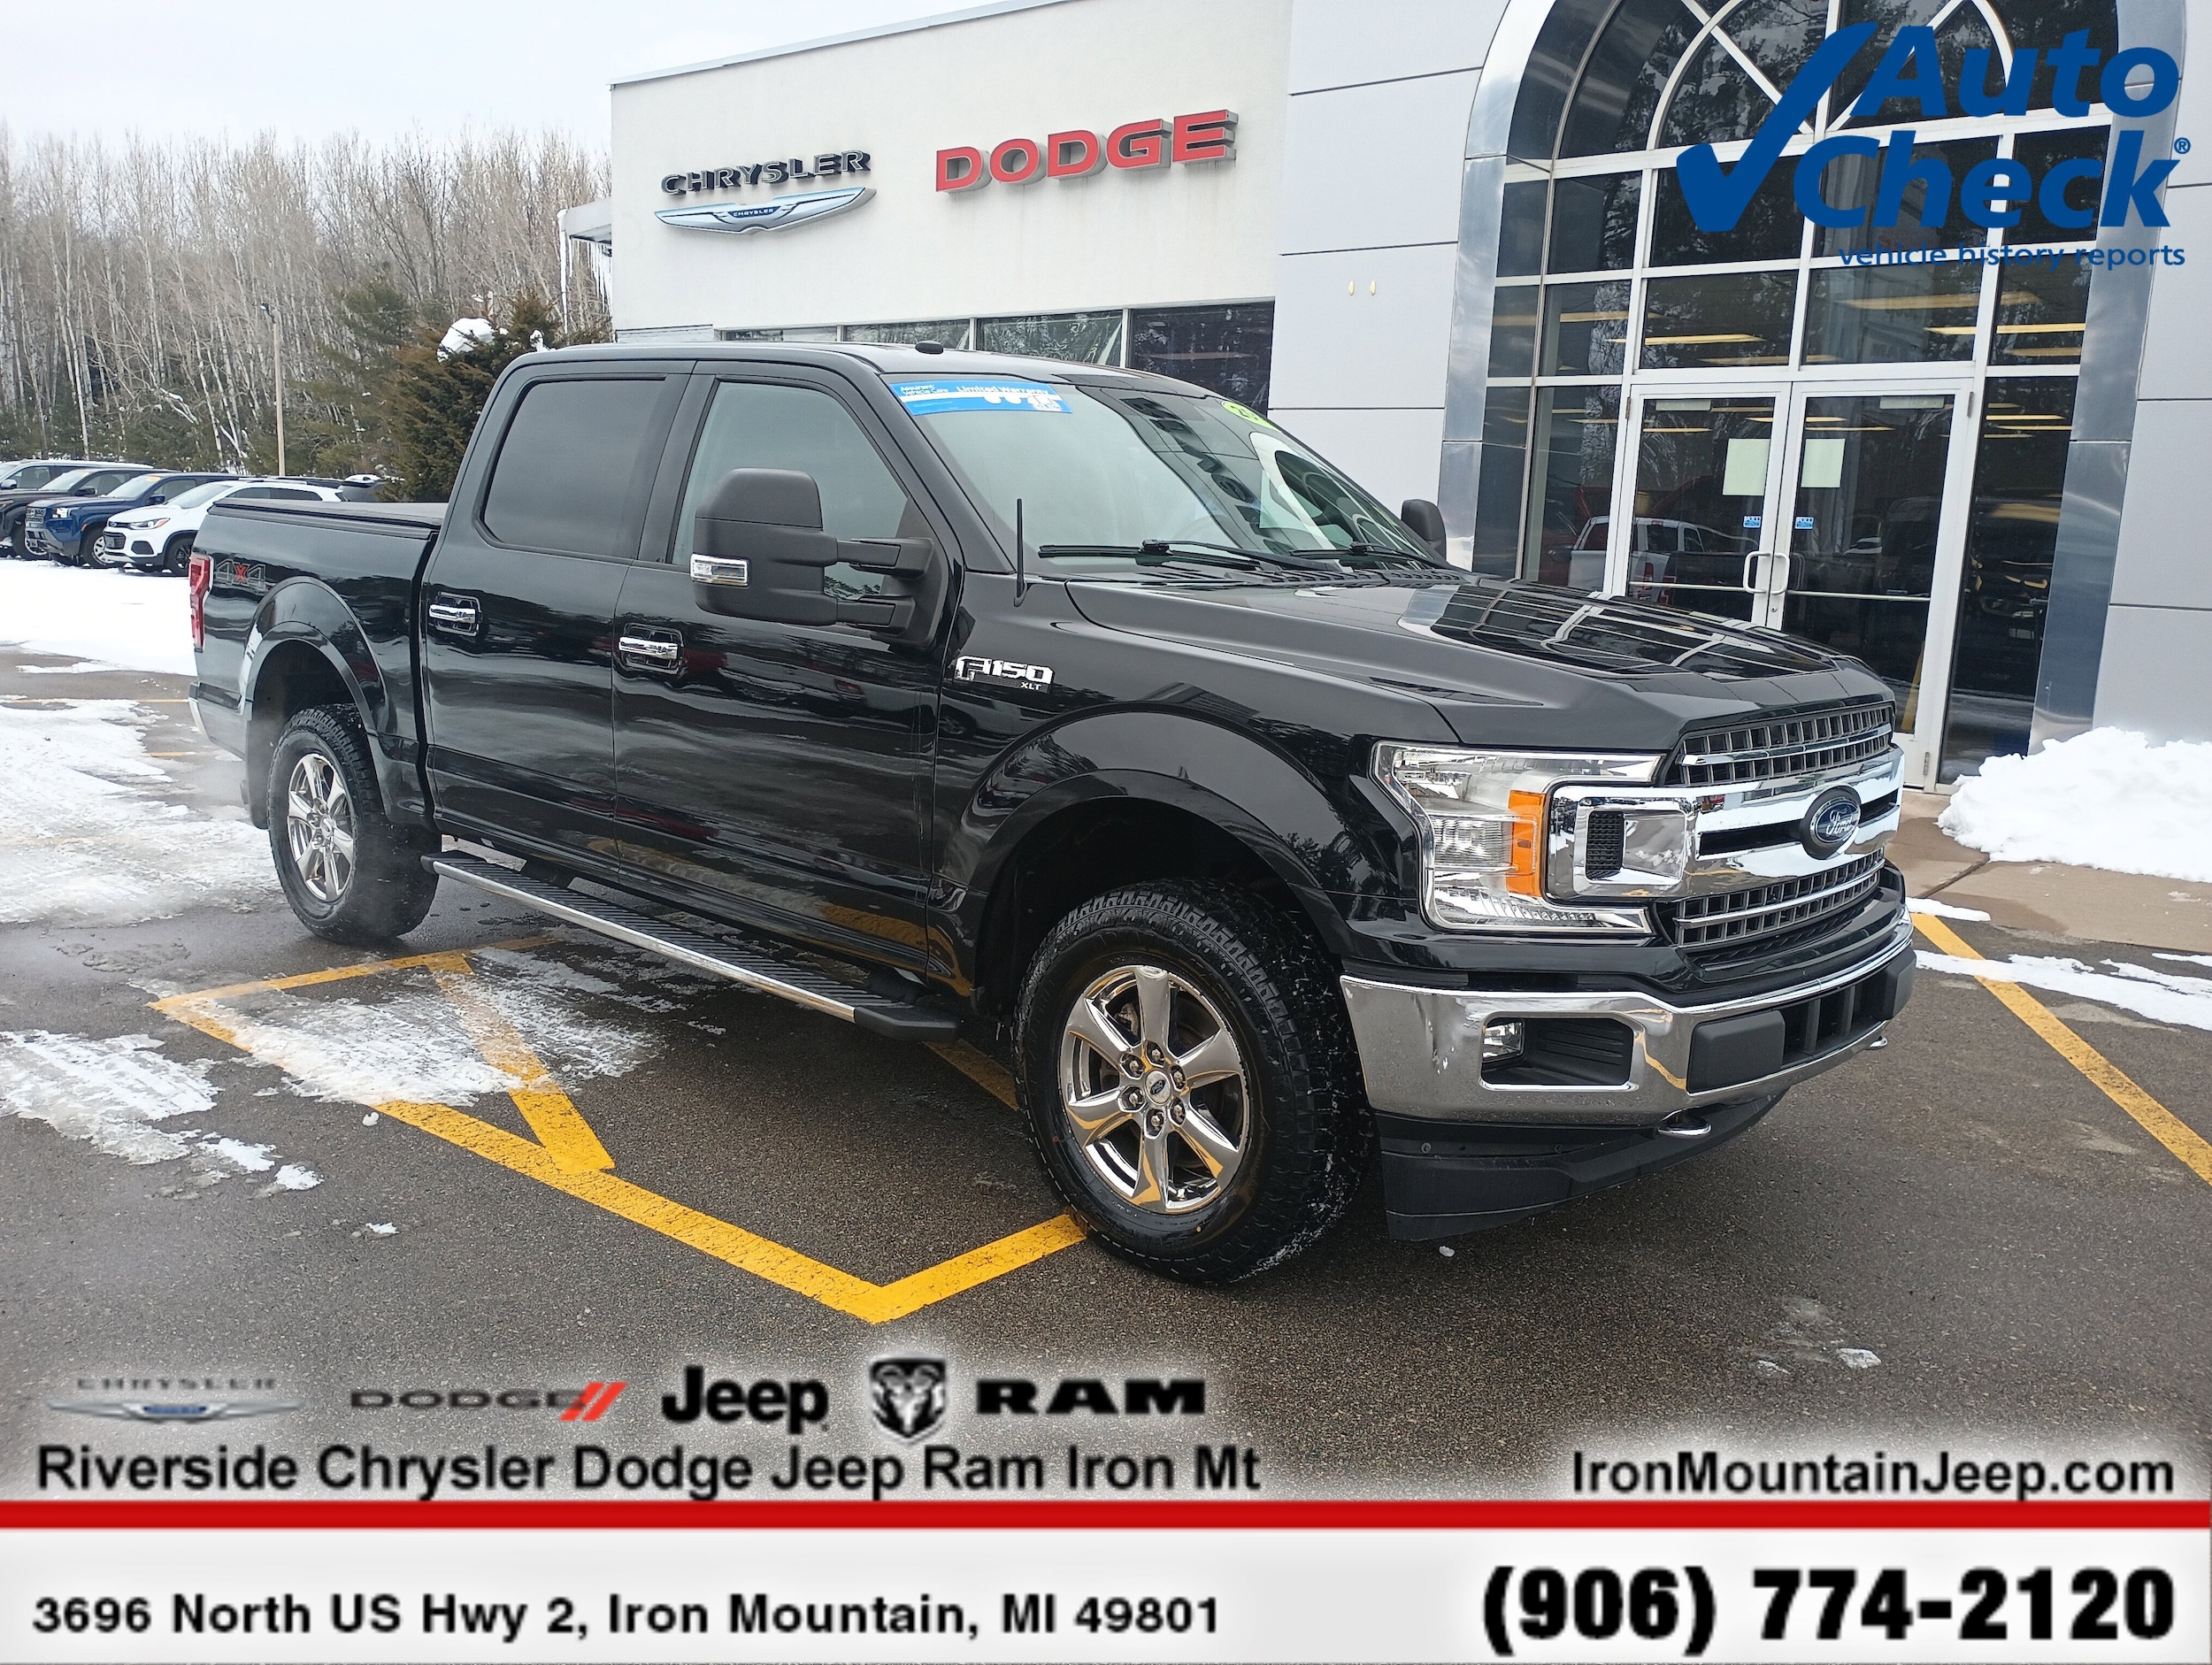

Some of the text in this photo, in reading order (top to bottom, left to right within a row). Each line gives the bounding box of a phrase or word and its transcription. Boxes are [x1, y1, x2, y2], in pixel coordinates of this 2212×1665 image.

[936, 109, 1239, 192] DODGE
[661, 150, 871, 196] CHRYSLER
[733, 208, 774, 217] CHRYSLER
[1020, 681, 1041, 690] XLT
[1825, 809, 1855, 836] Ford
